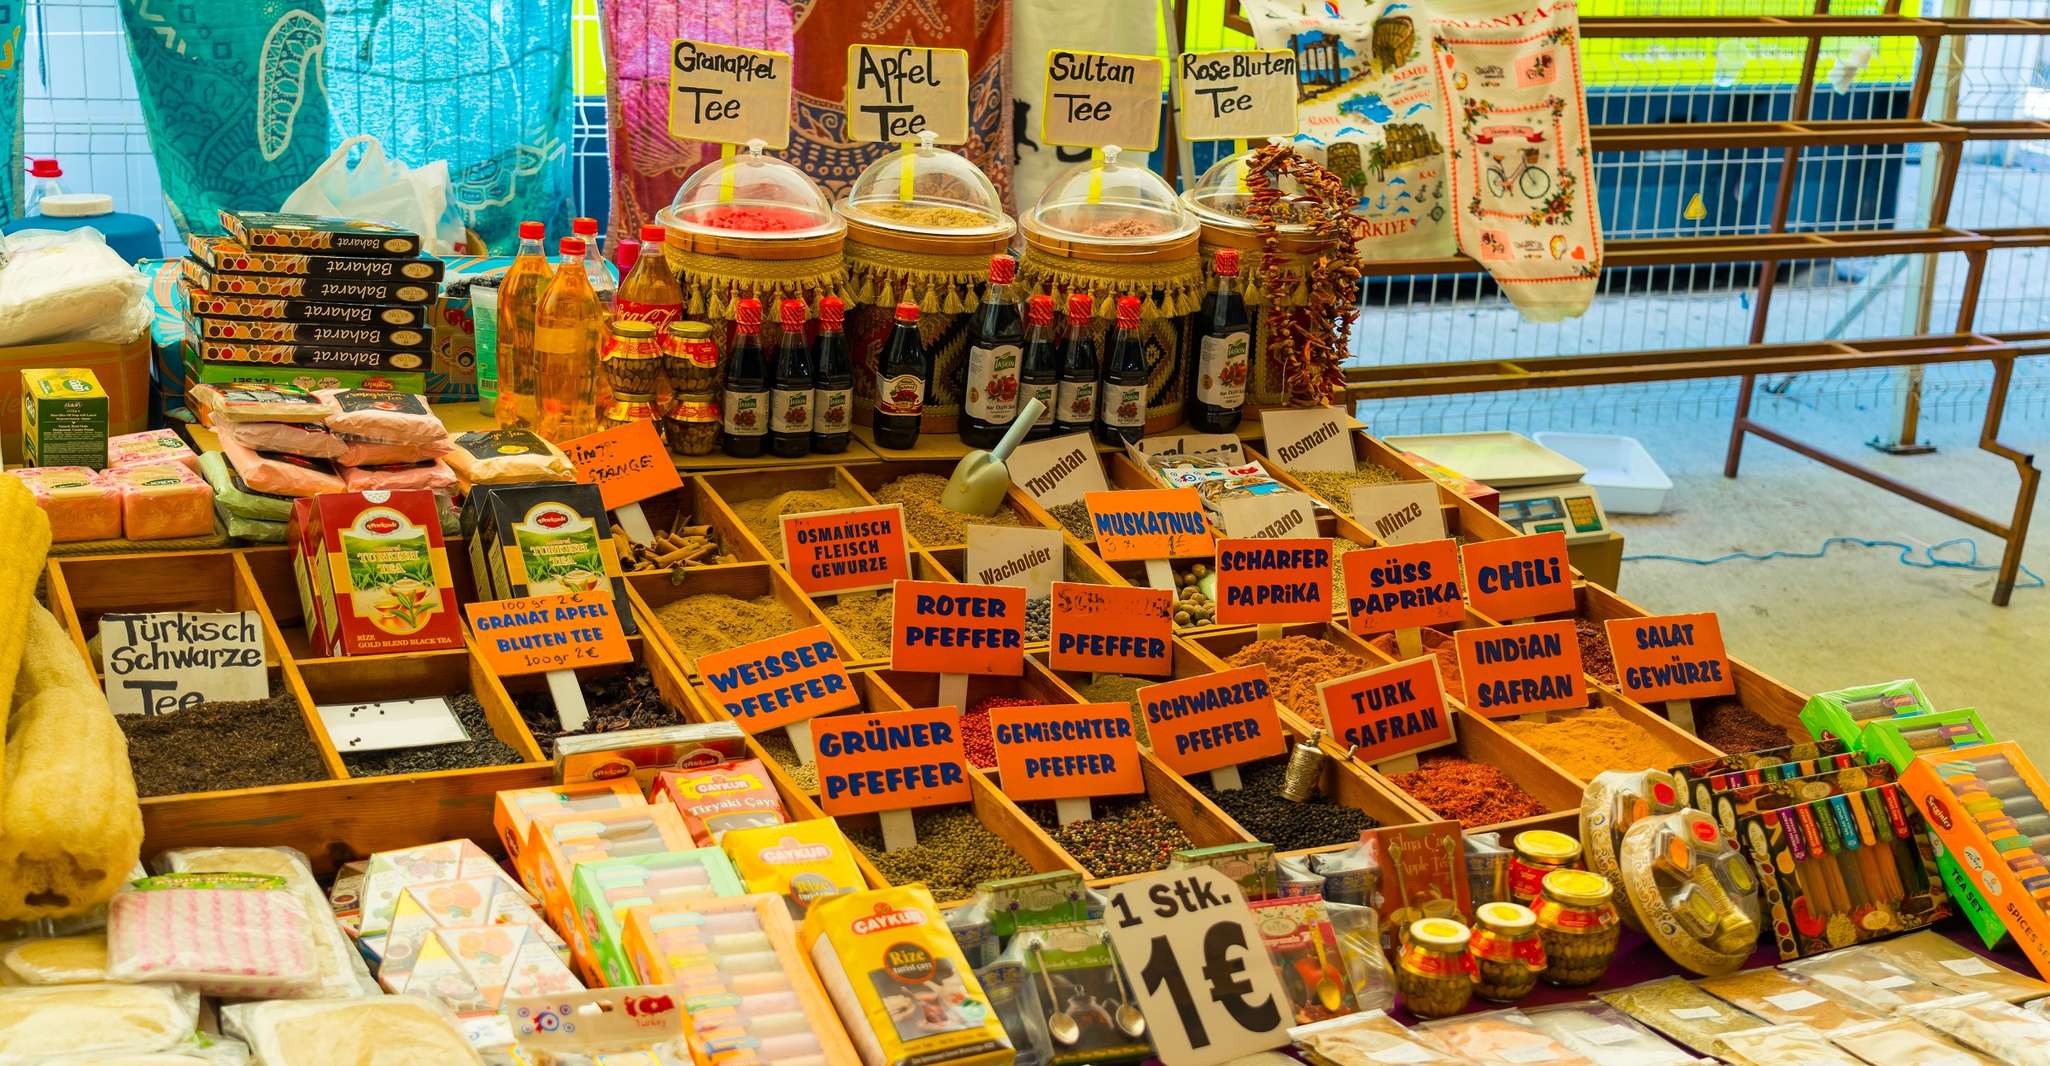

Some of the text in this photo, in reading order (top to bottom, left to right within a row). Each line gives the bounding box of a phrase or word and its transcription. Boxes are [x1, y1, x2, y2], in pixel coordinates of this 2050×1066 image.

[674, 42, 776, 82] Granapfel
[857, 47, 940, 103] Apfel
[1050, 52, 1135, 84] Sultan
[678, 86, 741, 124] Tee
[1054, 93, 1112, 123] Tee
[1195, 86, 1253, 118] Tee
[860, 105, 927, 142] Tee
[337, 238, 380, 249] Baharat
[326, 261, 392, 276] Baharat
[321, 284, 387, 299] Baharat
[304, 306, 372, 321] Baharat
[314, 329, 381, 343] Baharat
[313, 352, 380, 366] Baharat
[1277, 418, 1340, 465] Rosmarin
[1025, 448, 1087, 498] Thymian
[797, 520, 892, 545] OSMANISCH
[1095, 511, 1206, 537] MUSKATNUS
[1374, 499, 1423, 540] Minze
[814, 540, 880, 561] FLEISCH
[979, 546, 1051, 586] Wacholder
[1370, 558, 1431, 588] SÜSS
[476, 603, 608, 631] GRANAT APFEL
[501, 601, 526, 610] 100
[531, 600, 546, 609] gr
[917, 595, 1006, 618] ROTER
[102, 612, 256, 646] Türkisch
[358, 636, 452, 649] GOLD BLEND BLACK TEA
[497, 627, 604, 653] BLUTEN TEE
[906, 626, 1021, 648] PFEFFER
[1636, 624, 1694, 650] SALAT
[111, 642, 262, 675] Schwarze
[1060, 633, 1165, 658] PFEFFER
[1626, 656, 1722, 690] GEWÜRZE
[123, 680, 204, 717] Tee
[725, 674, 847, 719] PFEFFER
[1148, 678, 1270, 724] SCHWARZER
[1352, 679, 1416, 714] TURK
[1478, 674, 1573, 708] SAFRAN
[818, 720, 954, 758] GRÜNER
[1176, 718, 1262, 755] PFEFFER
[1345, 707, 1438, 748] SAFRAN
[826, 761, 964, 799] PFEFFER
[1026, 753, 1116, 778] PFEFFER
[1111, 877, 1232, 928] 1 Stk.
[1952, 868, 1966, 891] TEA
[1966, 891, 1984, 913] SET
[2007, 902, 2038, 943] SPICES
[890, 950, 925, 965] Rize
